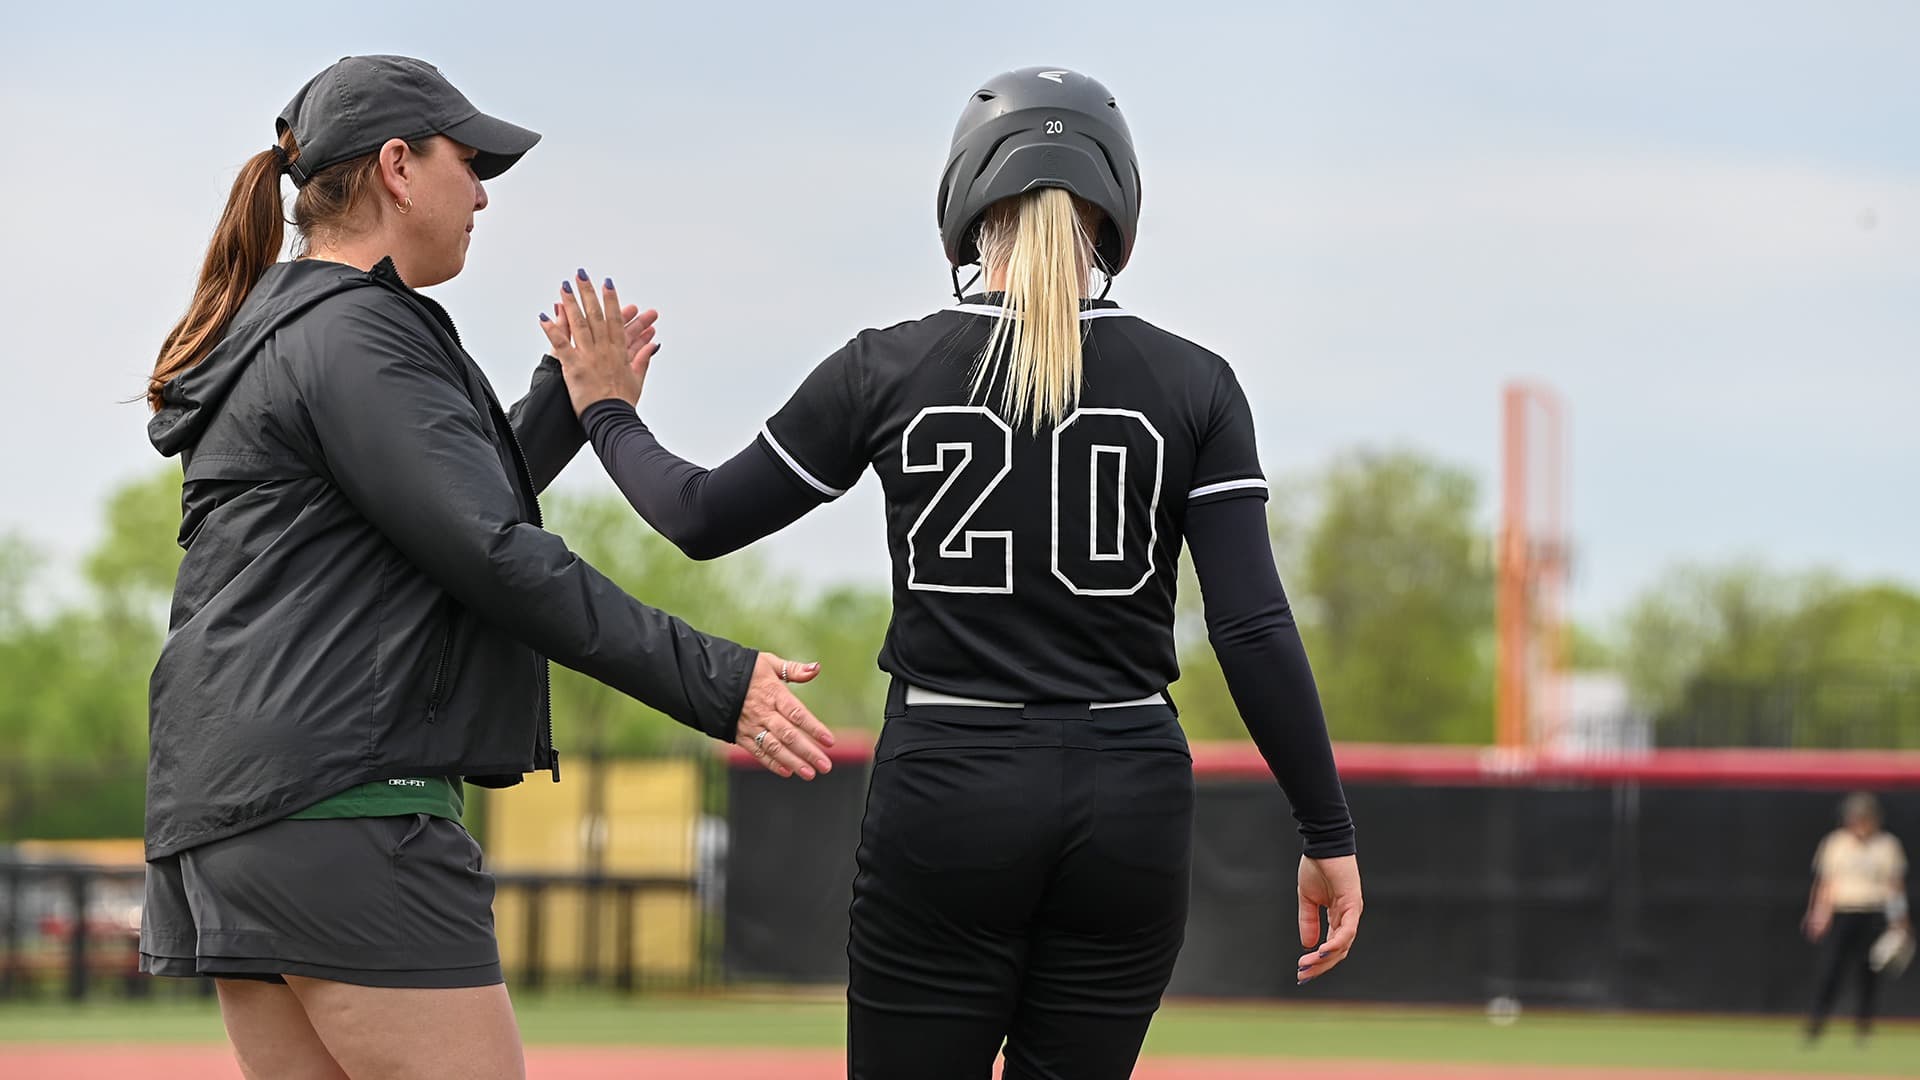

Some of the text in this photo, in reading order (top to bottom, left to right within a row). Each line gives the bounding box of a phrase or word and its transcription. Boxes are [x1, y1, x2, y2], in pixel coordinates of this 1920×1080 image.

[1045, 120, 1063, 134] 20
[902, 405, 1164, 595] 20
[388, 779, 426, 787] DRI-FIT
